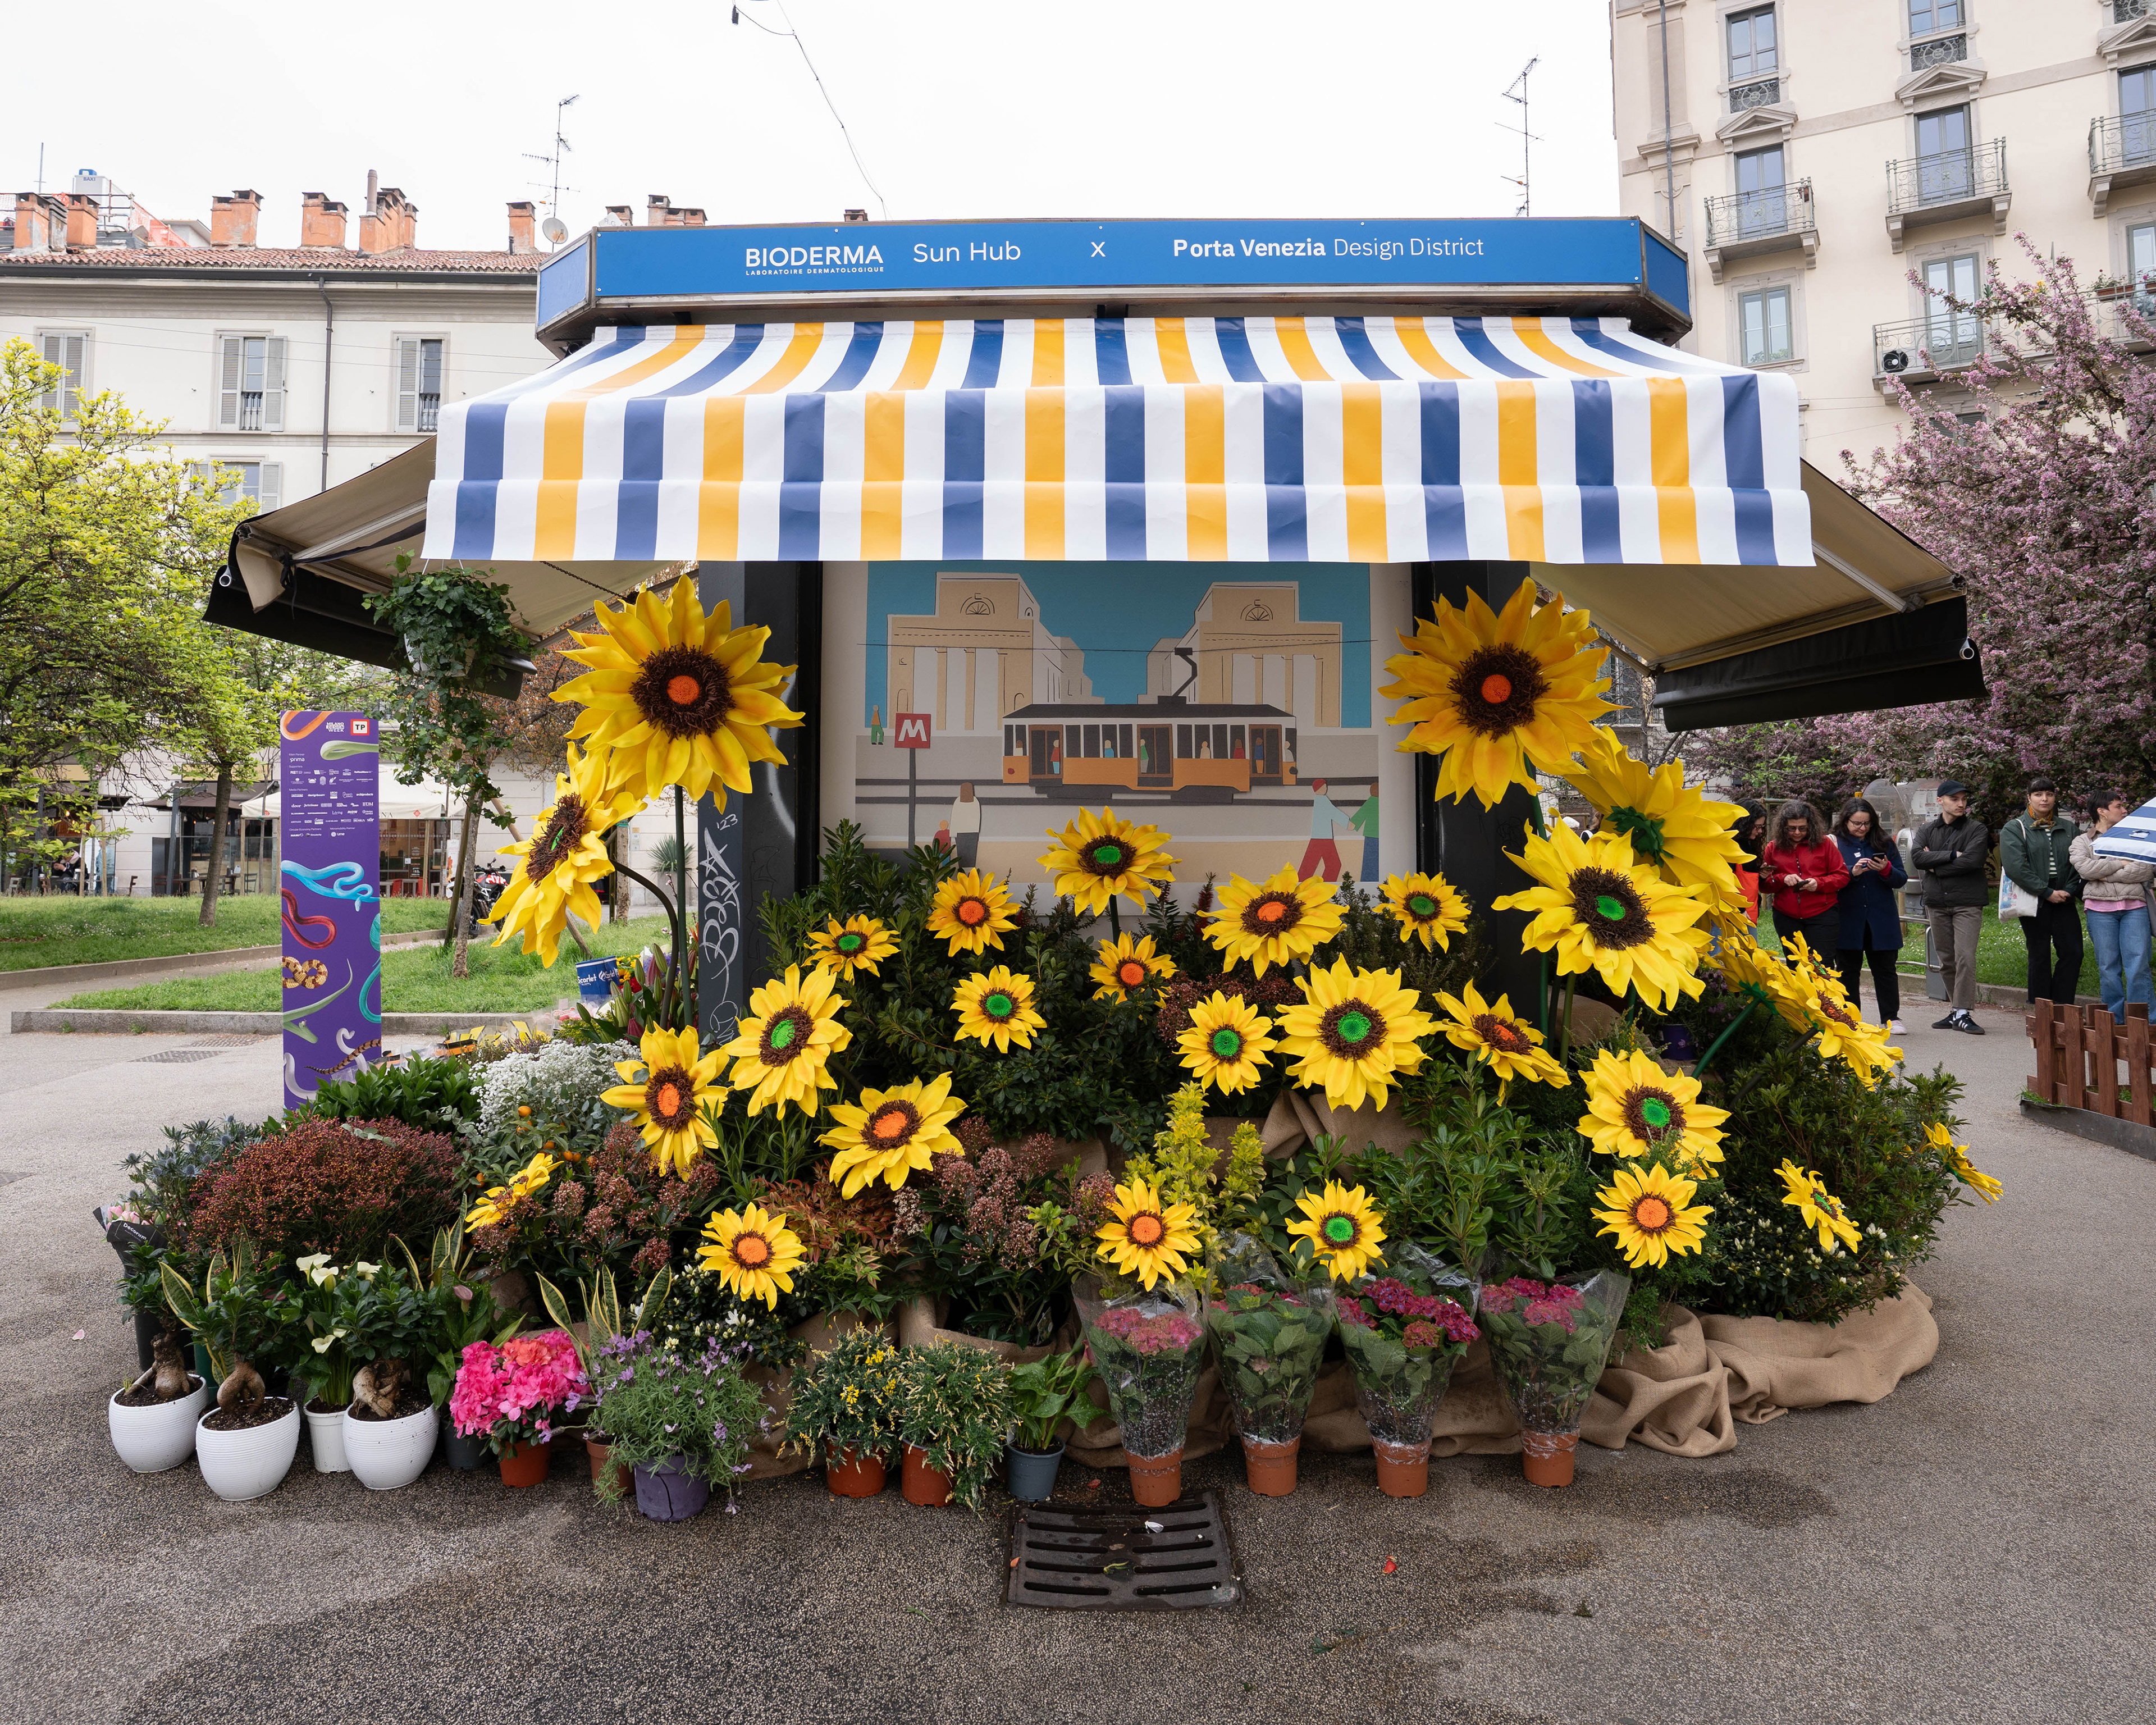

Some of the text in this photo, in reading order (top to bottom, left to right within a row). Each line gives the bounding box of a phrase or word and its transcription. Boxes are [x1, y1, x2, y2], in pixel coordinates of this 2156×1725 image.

[746, 245, 884, 267] BIODERMA
[913, 240, 1021, 263] Sun Hub
[1173, 238, 1484, 261] Porta Venezia Design District
[898, 719, 927, 741] M
[124, 1222, 147, 1240] Decorum
